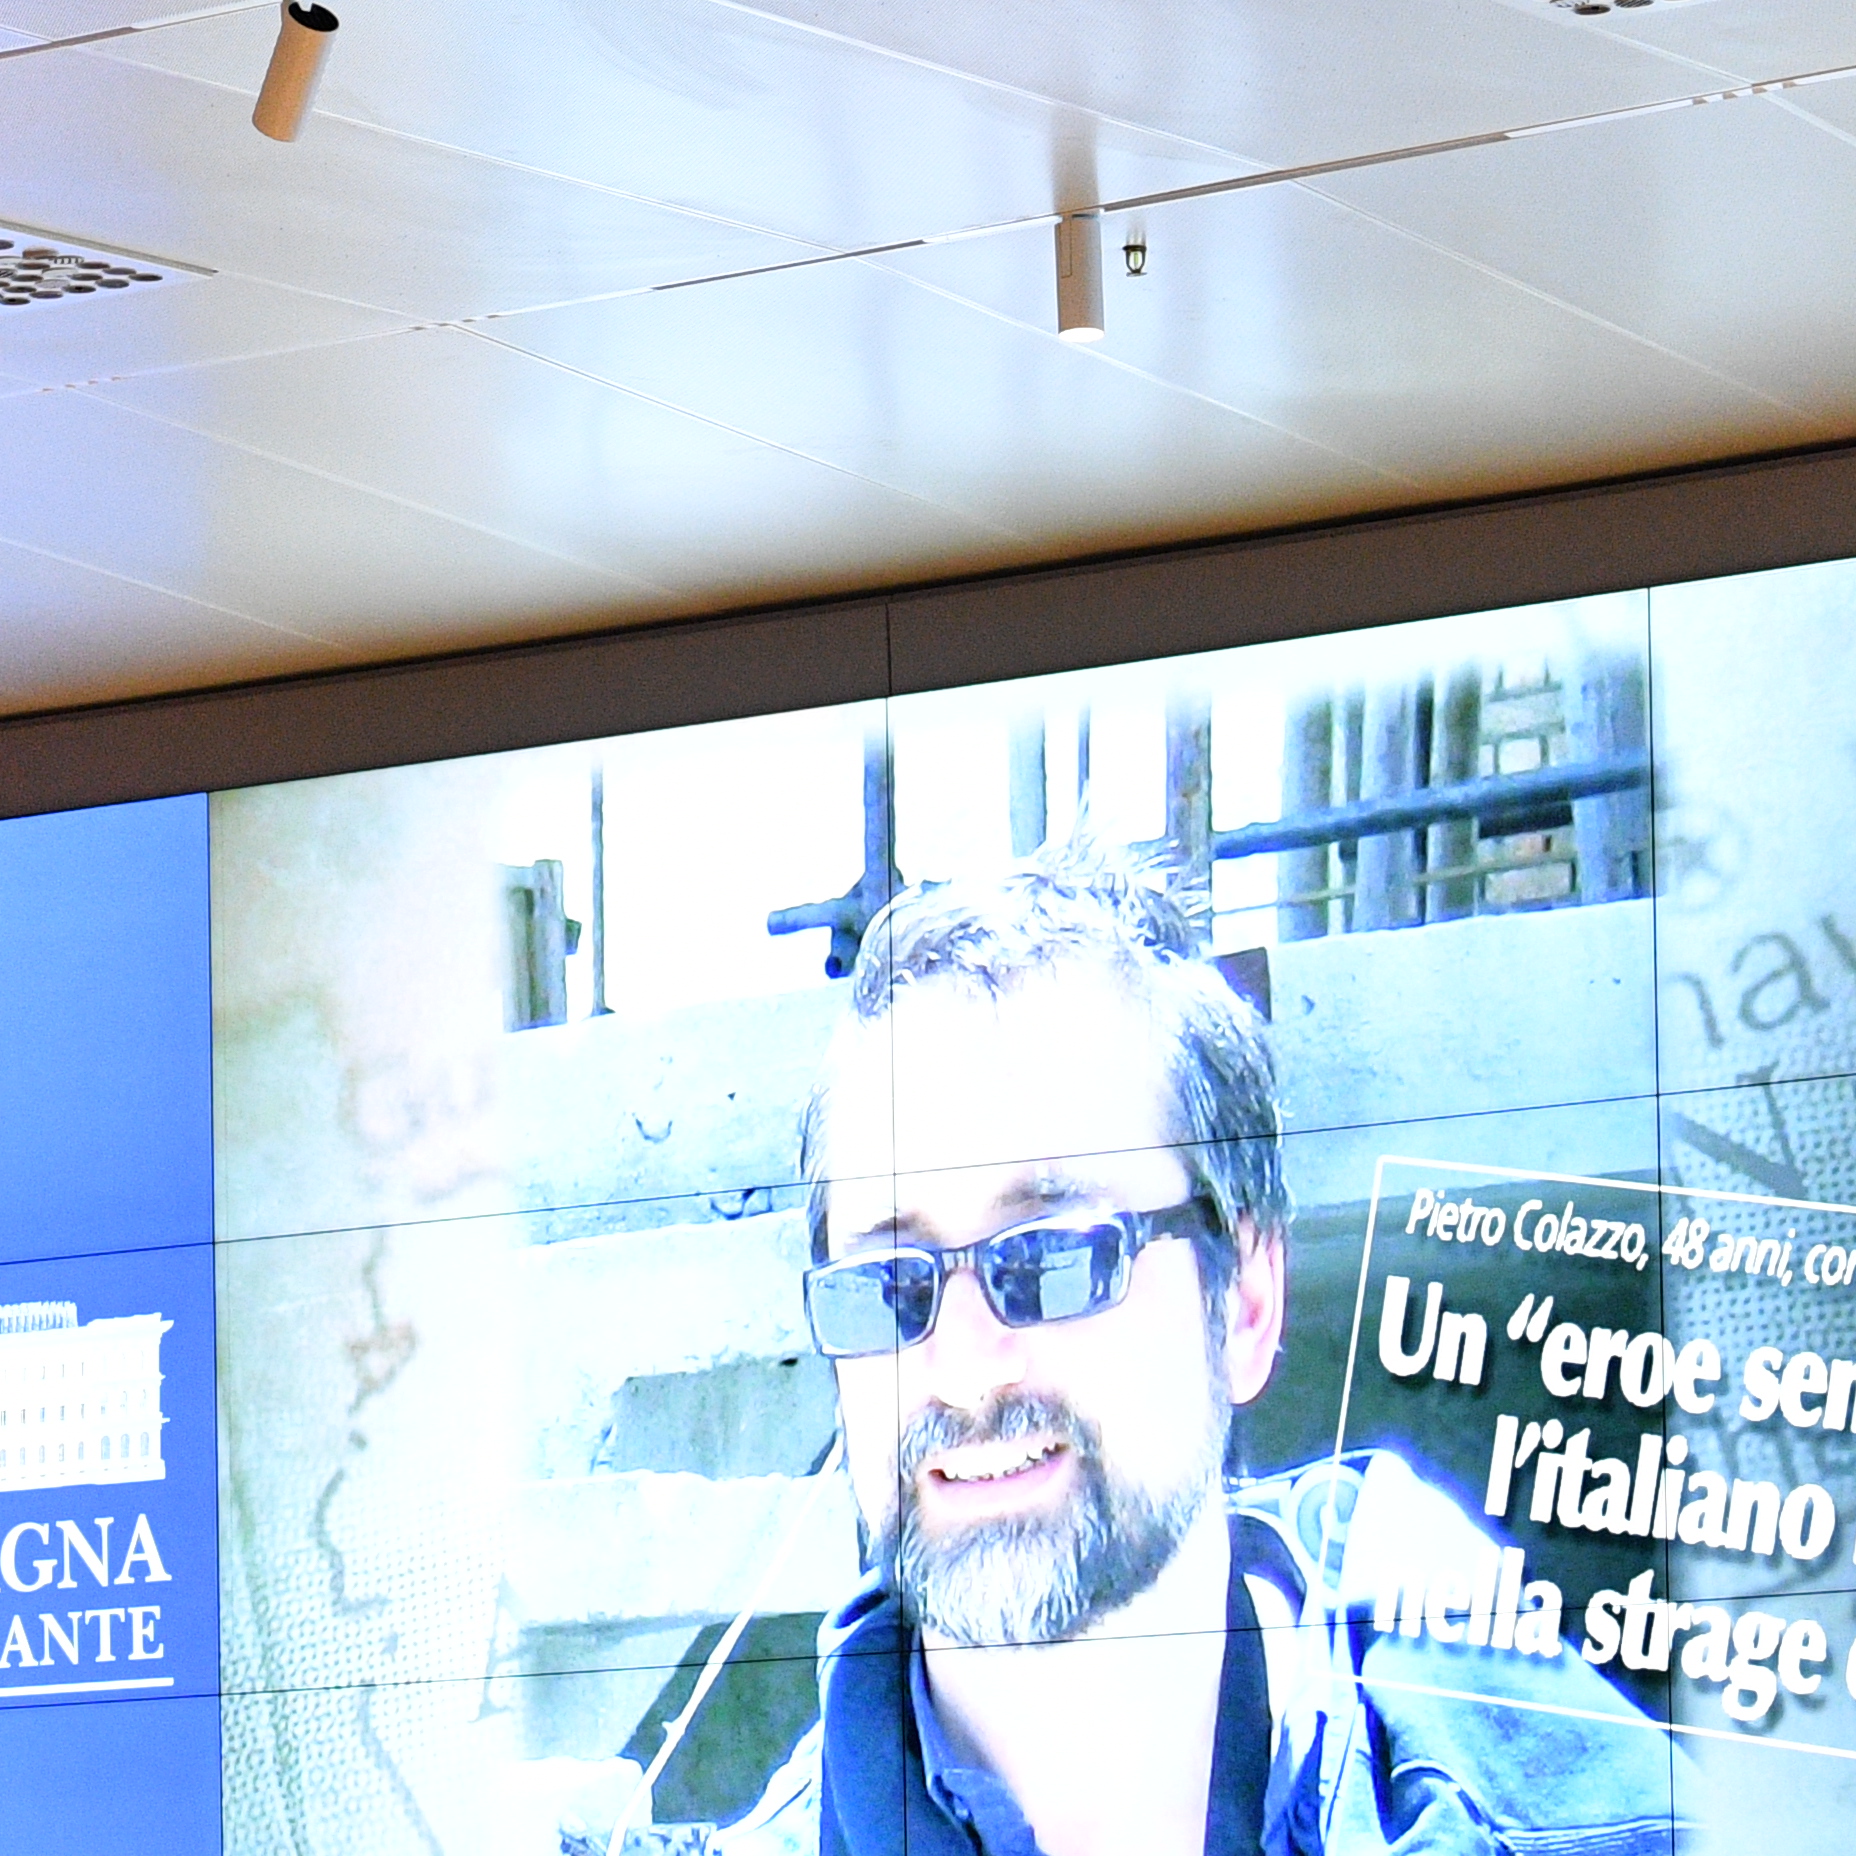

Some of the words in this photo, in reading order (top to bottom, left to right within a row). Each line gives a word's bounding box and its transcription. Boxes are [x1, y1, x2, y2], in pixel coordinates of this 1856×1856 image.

[1405, 1187, 1507, 1246] Pietro
[1513, 1199, 1650, 1272] Colazzo,
[1661, 1217, 1710, 1269] 48
[1709, 1228, 1797, 1287] anni,
[1376, 1274, 1487, 1389] Un
[1372, 1546, 1564, 1658] nella
[1582, 1569, 1828, 1722] strage
